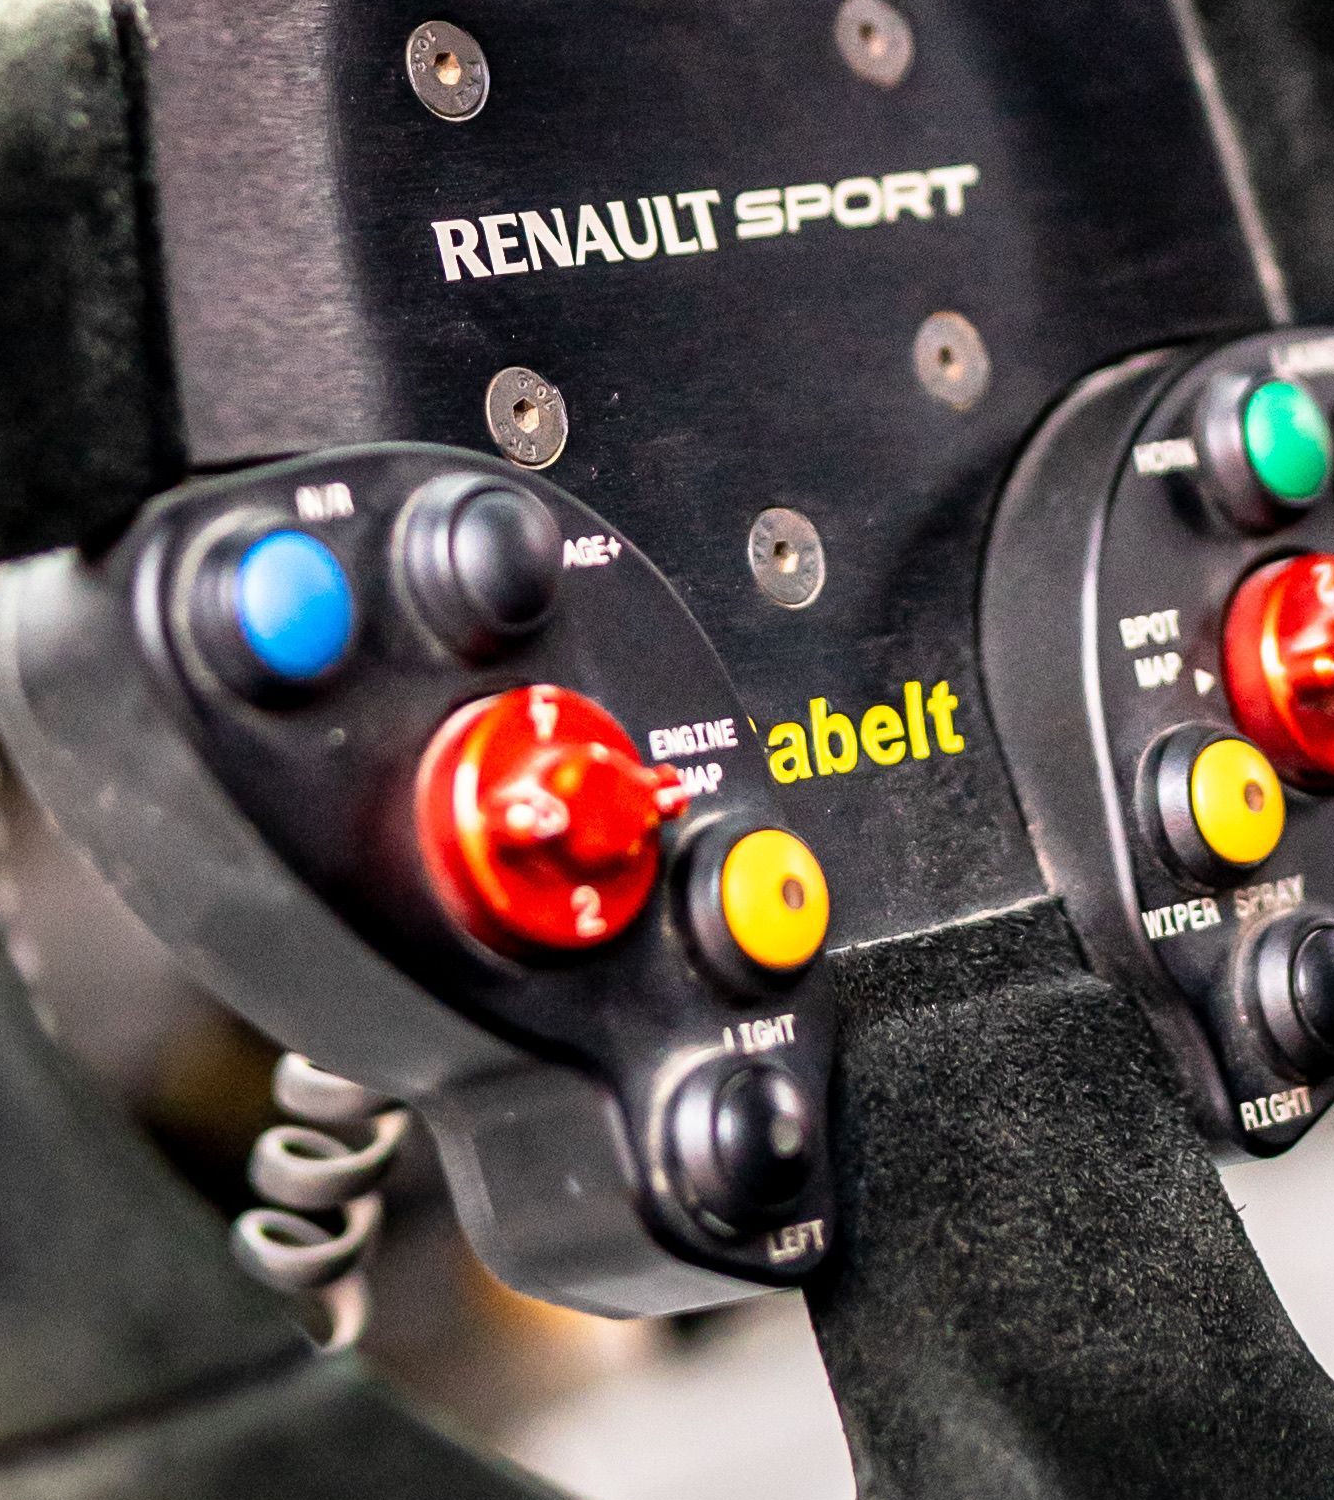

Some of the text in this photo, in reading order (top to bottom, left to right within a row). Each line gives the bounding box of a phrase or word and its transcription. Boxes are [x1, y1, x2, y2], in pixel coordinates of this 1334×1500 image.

[430, 164, 978, 282] RENAULT SPORT
[1134, 652, 1183, 689] MAP
[648, 718, 738, 760] ENGINE
[746, 680, 965, 784] abelt
[570, 884, 608, 939] 2
[1141, 873, 1305, 940] WIPER SPRAY
[1239, 1086, 1313, 1131] RIGHT
[768, 1218, 825, 1264] LEFT
